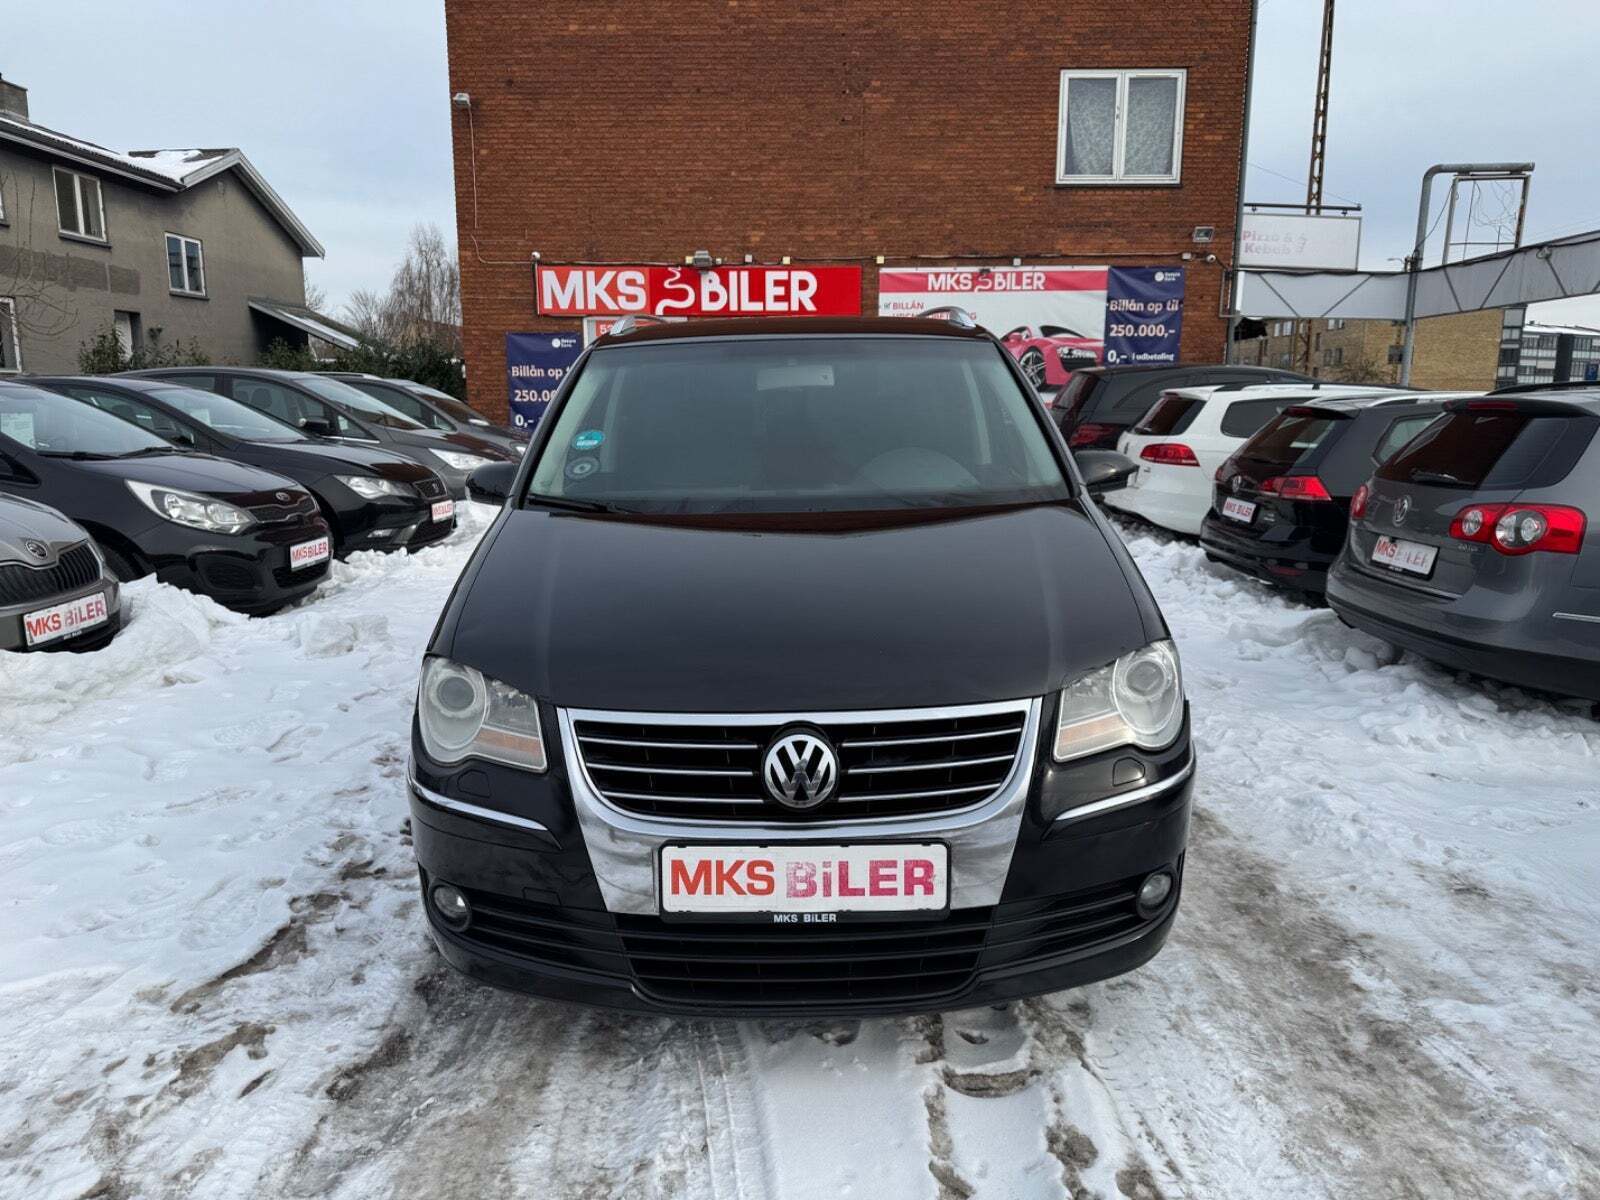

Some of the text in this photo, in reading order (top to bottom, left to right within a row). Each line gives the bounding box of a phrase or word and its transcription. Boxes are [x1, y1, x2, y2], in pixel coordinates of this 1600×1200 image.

[542, 269, 818, 312] MKS BILER
[927, 271, 1046, 292] MKS BILER
[1109, 298, 1179, 315] Billån op til
[1109, 323, 1176, 339] 250.000,-
[1107, 349, 1128, 364] 0,-
[511, 364, 545, 377] Billån
[547, 367, 563, 380] op
[1376, 538, 1398, 559] MKS
[26, 613, 62, 638] MKS
[670, 859, 936, 899] MKS BiLER
[773, 913, 799, 923] MKS
